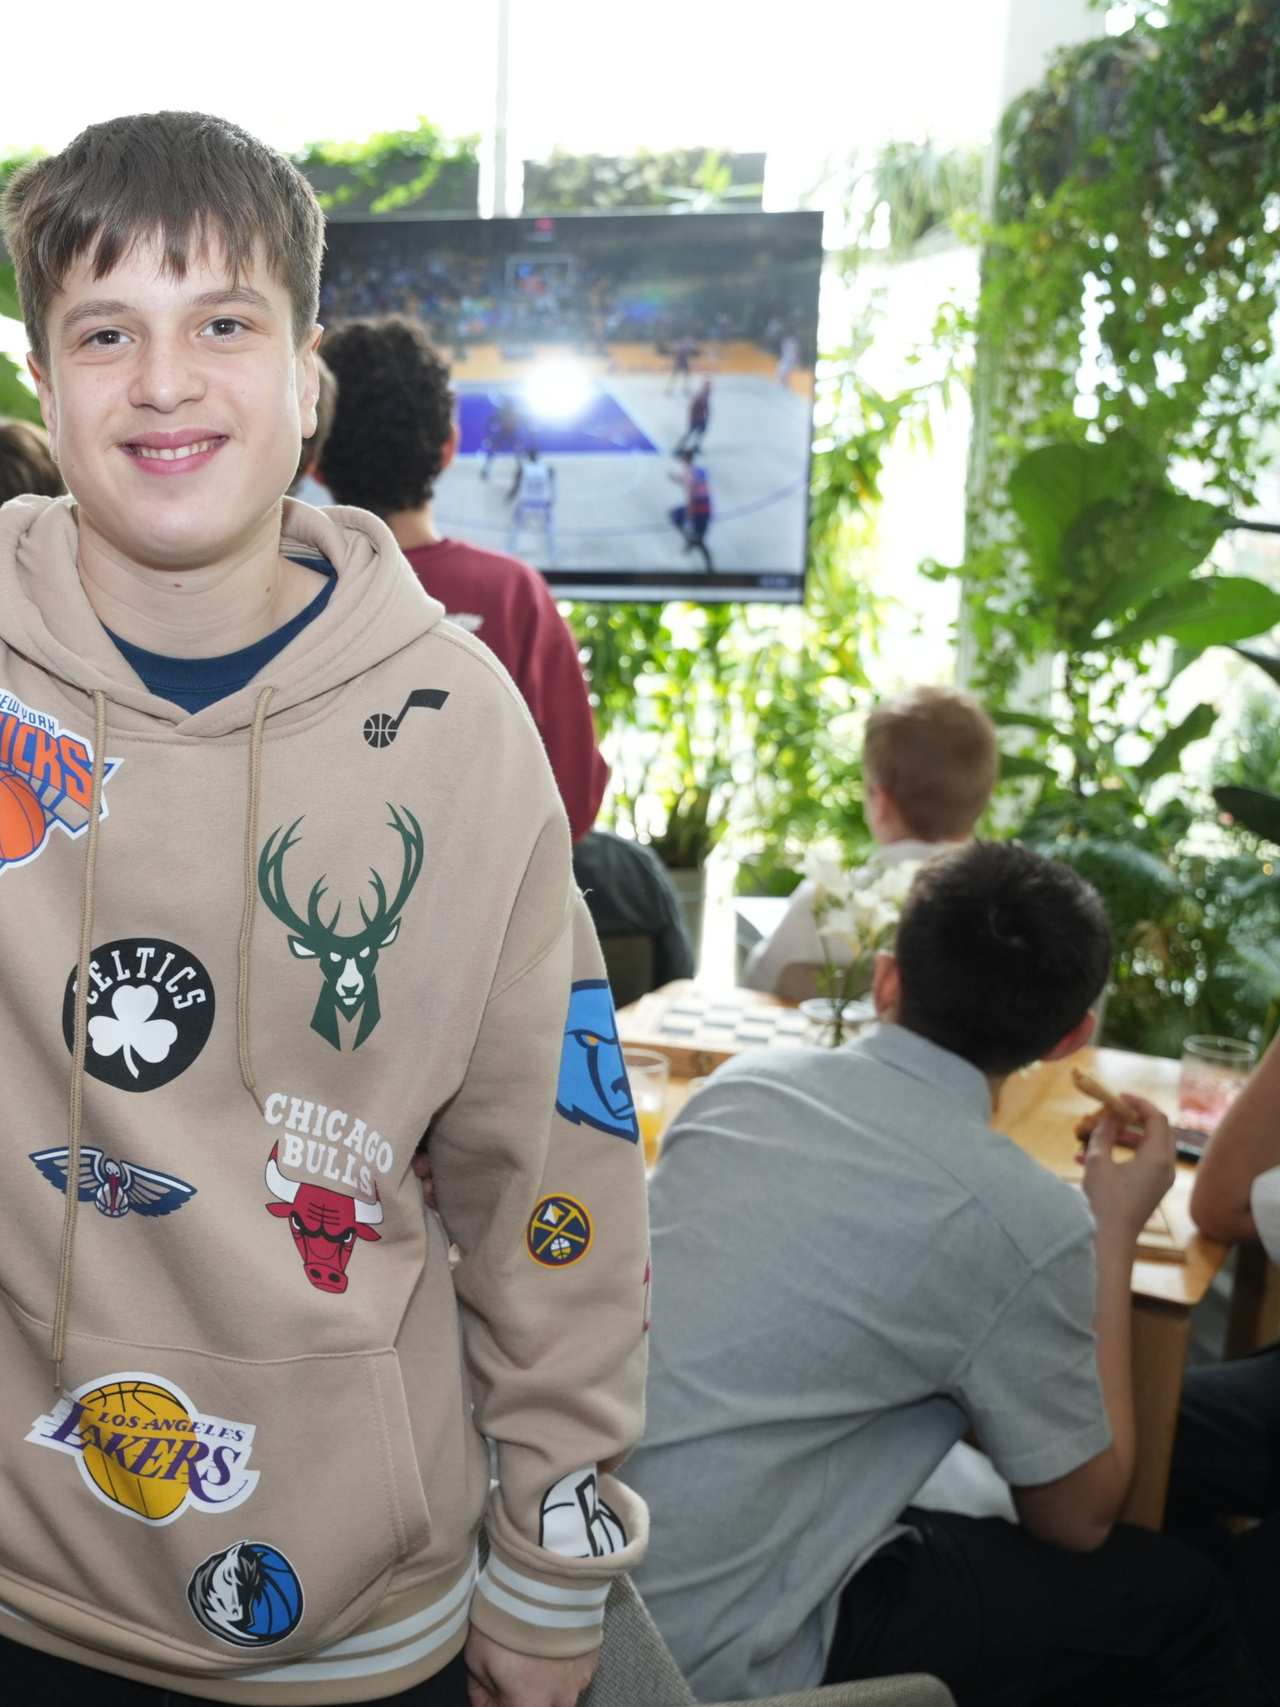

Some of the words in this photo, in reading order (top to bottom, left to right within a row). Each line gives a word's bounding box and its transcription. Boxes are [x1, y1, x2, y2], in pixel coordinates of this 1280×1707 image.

[21, 709, 56, 734] YORK
[264, 1092, 394, 1174] CHICAGO
[282, 1133, 374, 1196] BULLS
[40, 1401, 248, 1504] LAKERS
[98, 1412, 140, 1429] LOS
[141, 1418, 246, 1442] ANGELES
